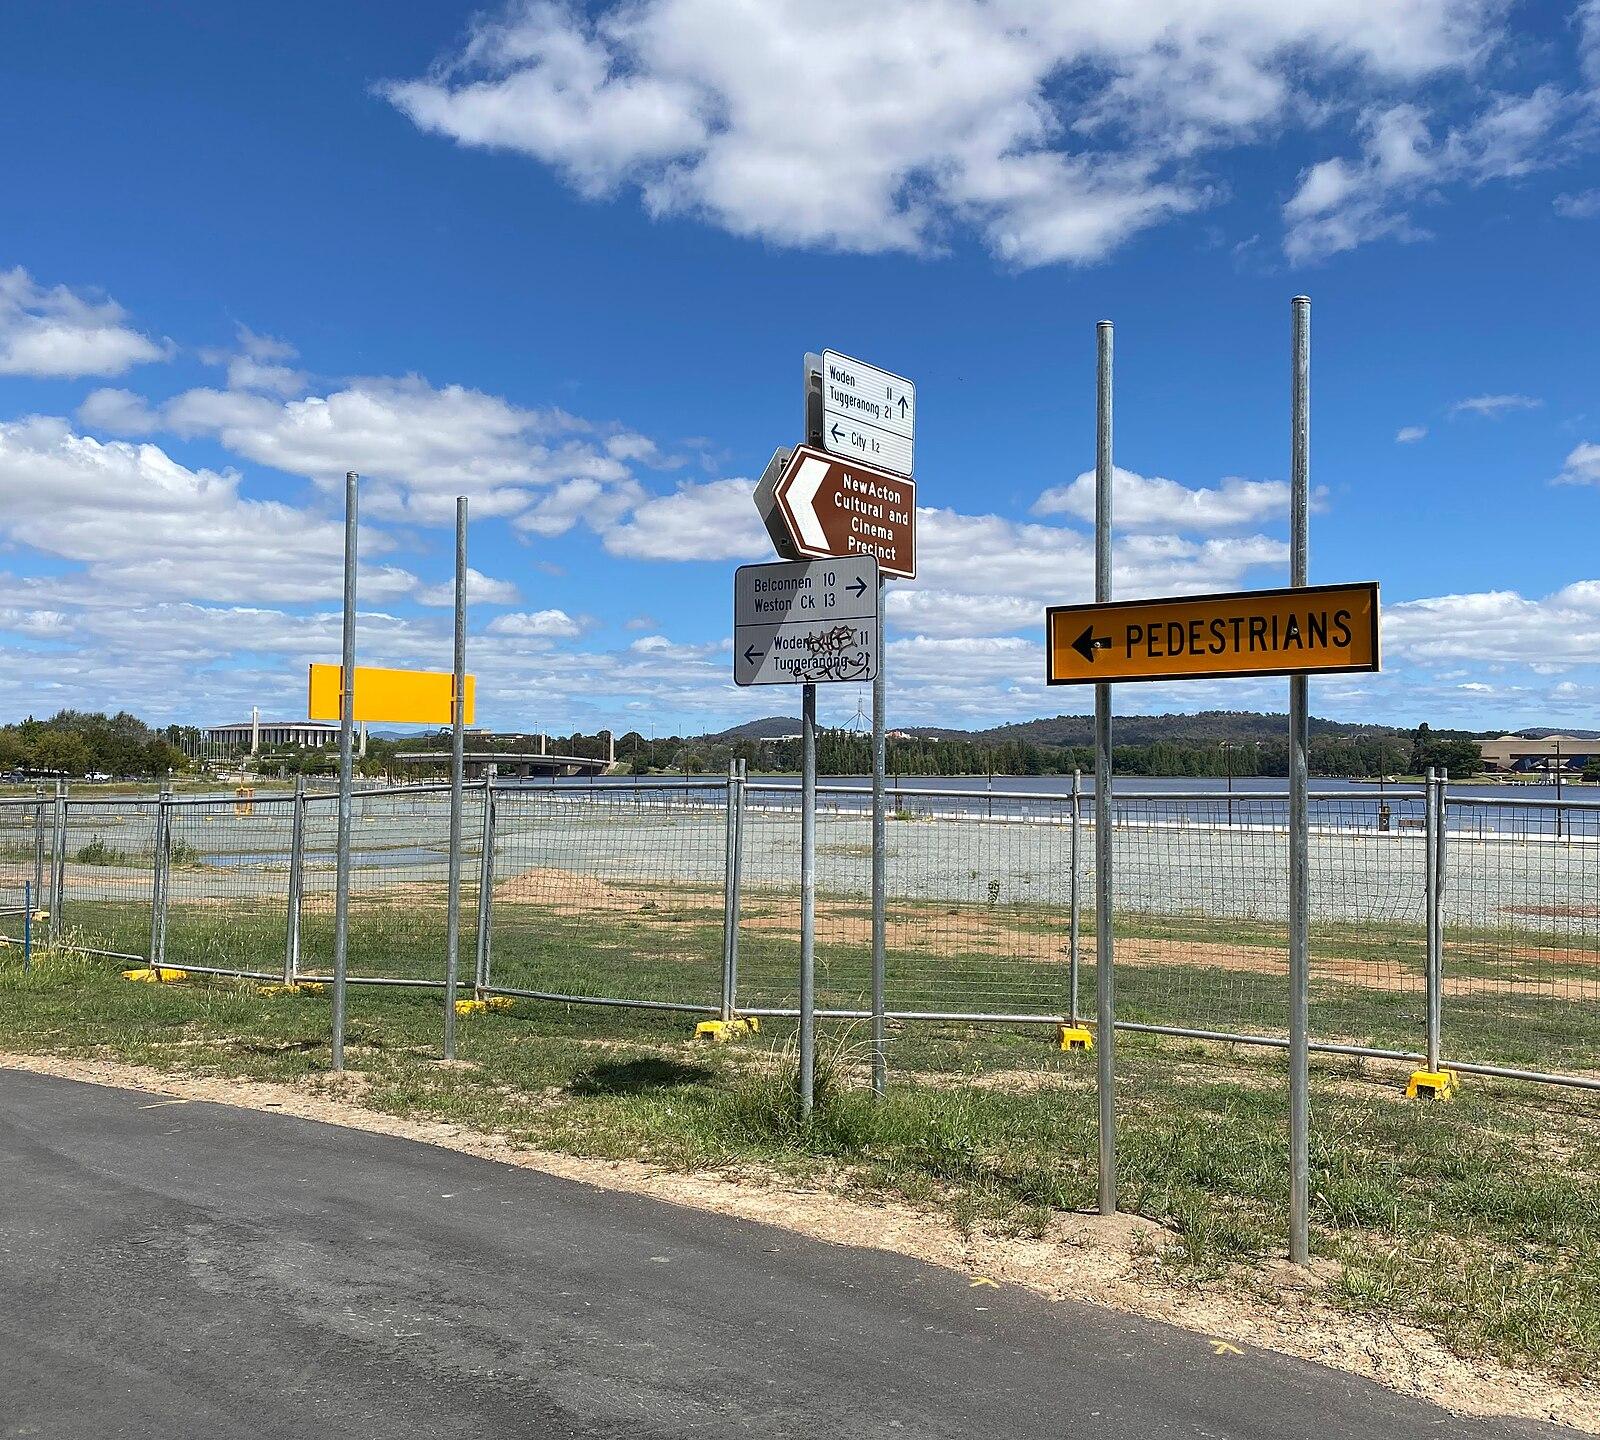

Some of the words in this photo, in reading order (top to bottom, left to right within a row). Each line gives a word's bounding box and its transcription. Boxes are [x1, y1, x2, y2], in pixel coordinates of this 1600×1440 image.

[829, 365, 855, 387] Woden
[886, 387, 892, 401] 11
[829, 386, 880, 419] Tuggeranong
[884, 405, 892, 420] 21
[851, 431, 866, 451] City
[843, 473, 901, 505] NewActon
[834, 491, 883, 519] Cultural
[889, 509, 908, 526] and
[851, 517, 893, 541] Cinema
[848, 536, 896, 561] Precinct
[754, 577, 812, 593] Belconnen
[823, 571, 836, 587] 10
[754, 598, 792, 613] Weston
[800, 594, 816, 609] Ck
[823, 593, 836, 608] 13
[773, 635, 811, 650] Woden
[859, 630, 869, 646] 11
[1125, 609, 1352, 659] PEDESTRIANS
[773, 656, 848, 674] Tuggeranong
